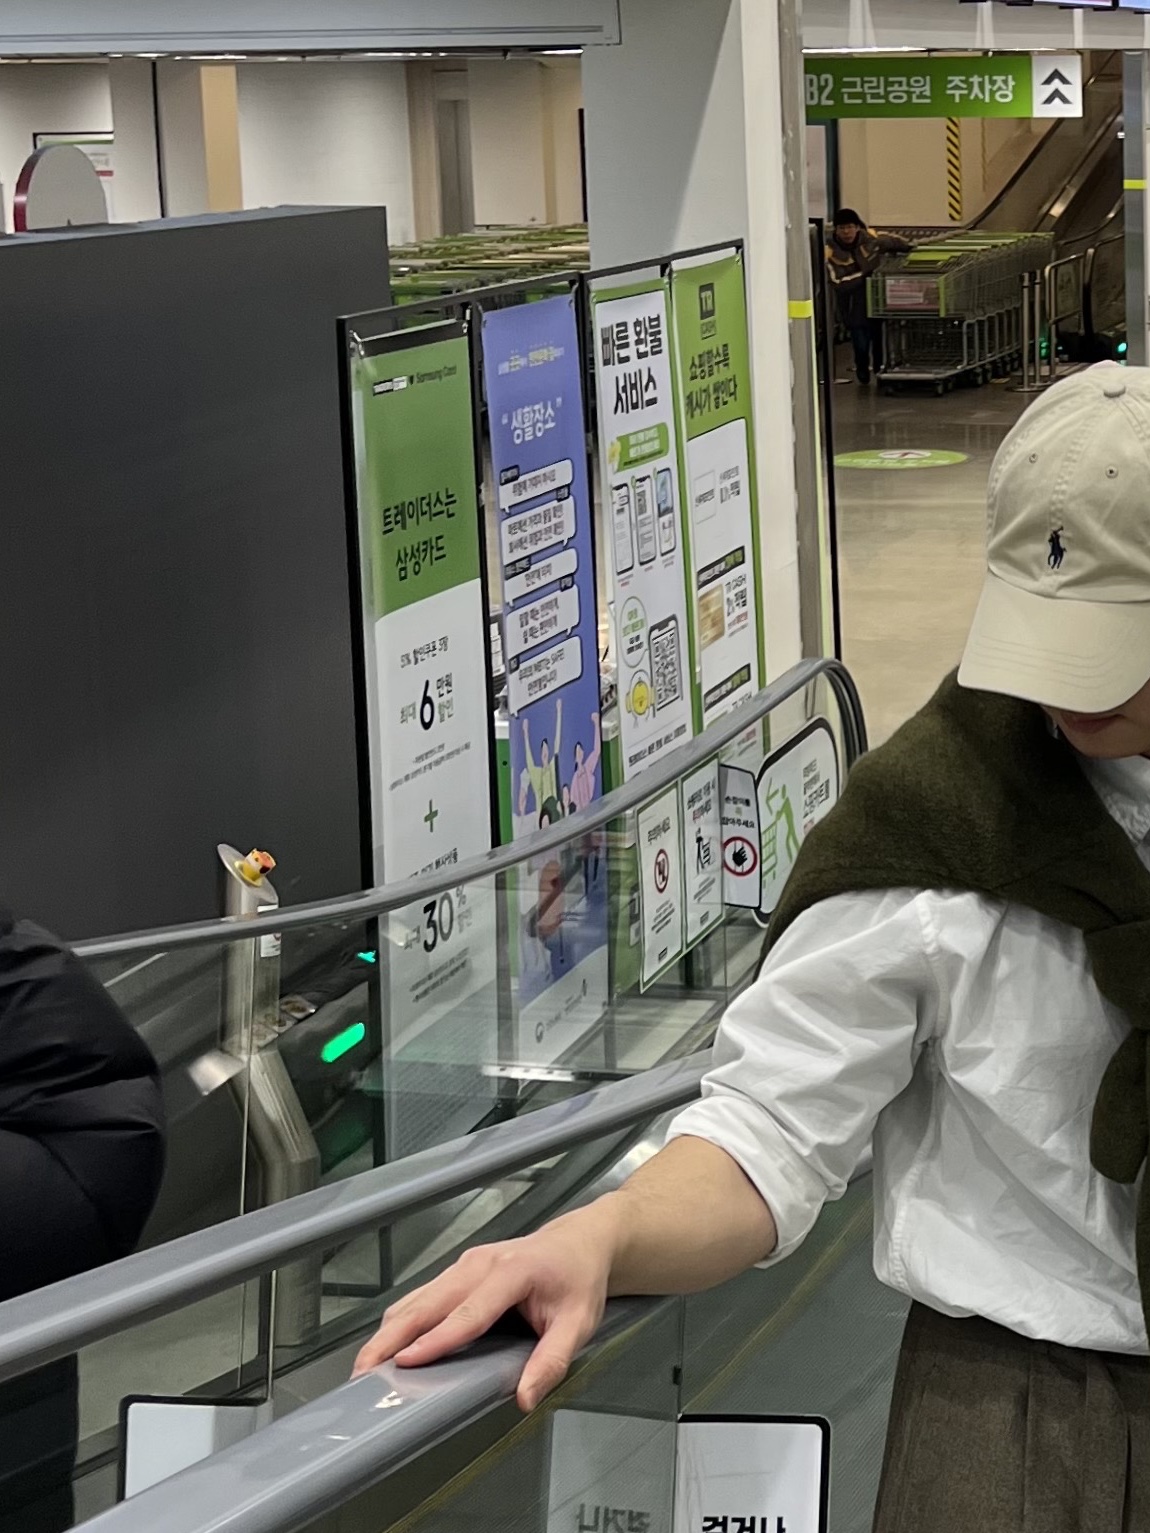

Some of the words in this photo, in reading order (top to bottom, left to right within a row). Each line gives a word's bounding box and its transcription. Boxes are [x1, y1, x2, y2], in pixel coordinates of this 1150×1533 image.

[804, 73, 834, 106] B2
[841, 75, 932, 104] 근린공원
[945, 75, 1016, 103] 주차장
[600, 320, 631, 367] 빠른
[633, 313, 663, 361] 환불
[688, 342, 730, 382] 쇼핑할수록
[613, 366, 658, 416] 서비스
[382, 487, 458, 536] 트레이더스는
[396, 534, 447, 582] 삼성카드
[419, 679, 435, 731] 6
[435, 672, 453, 699] 만원
